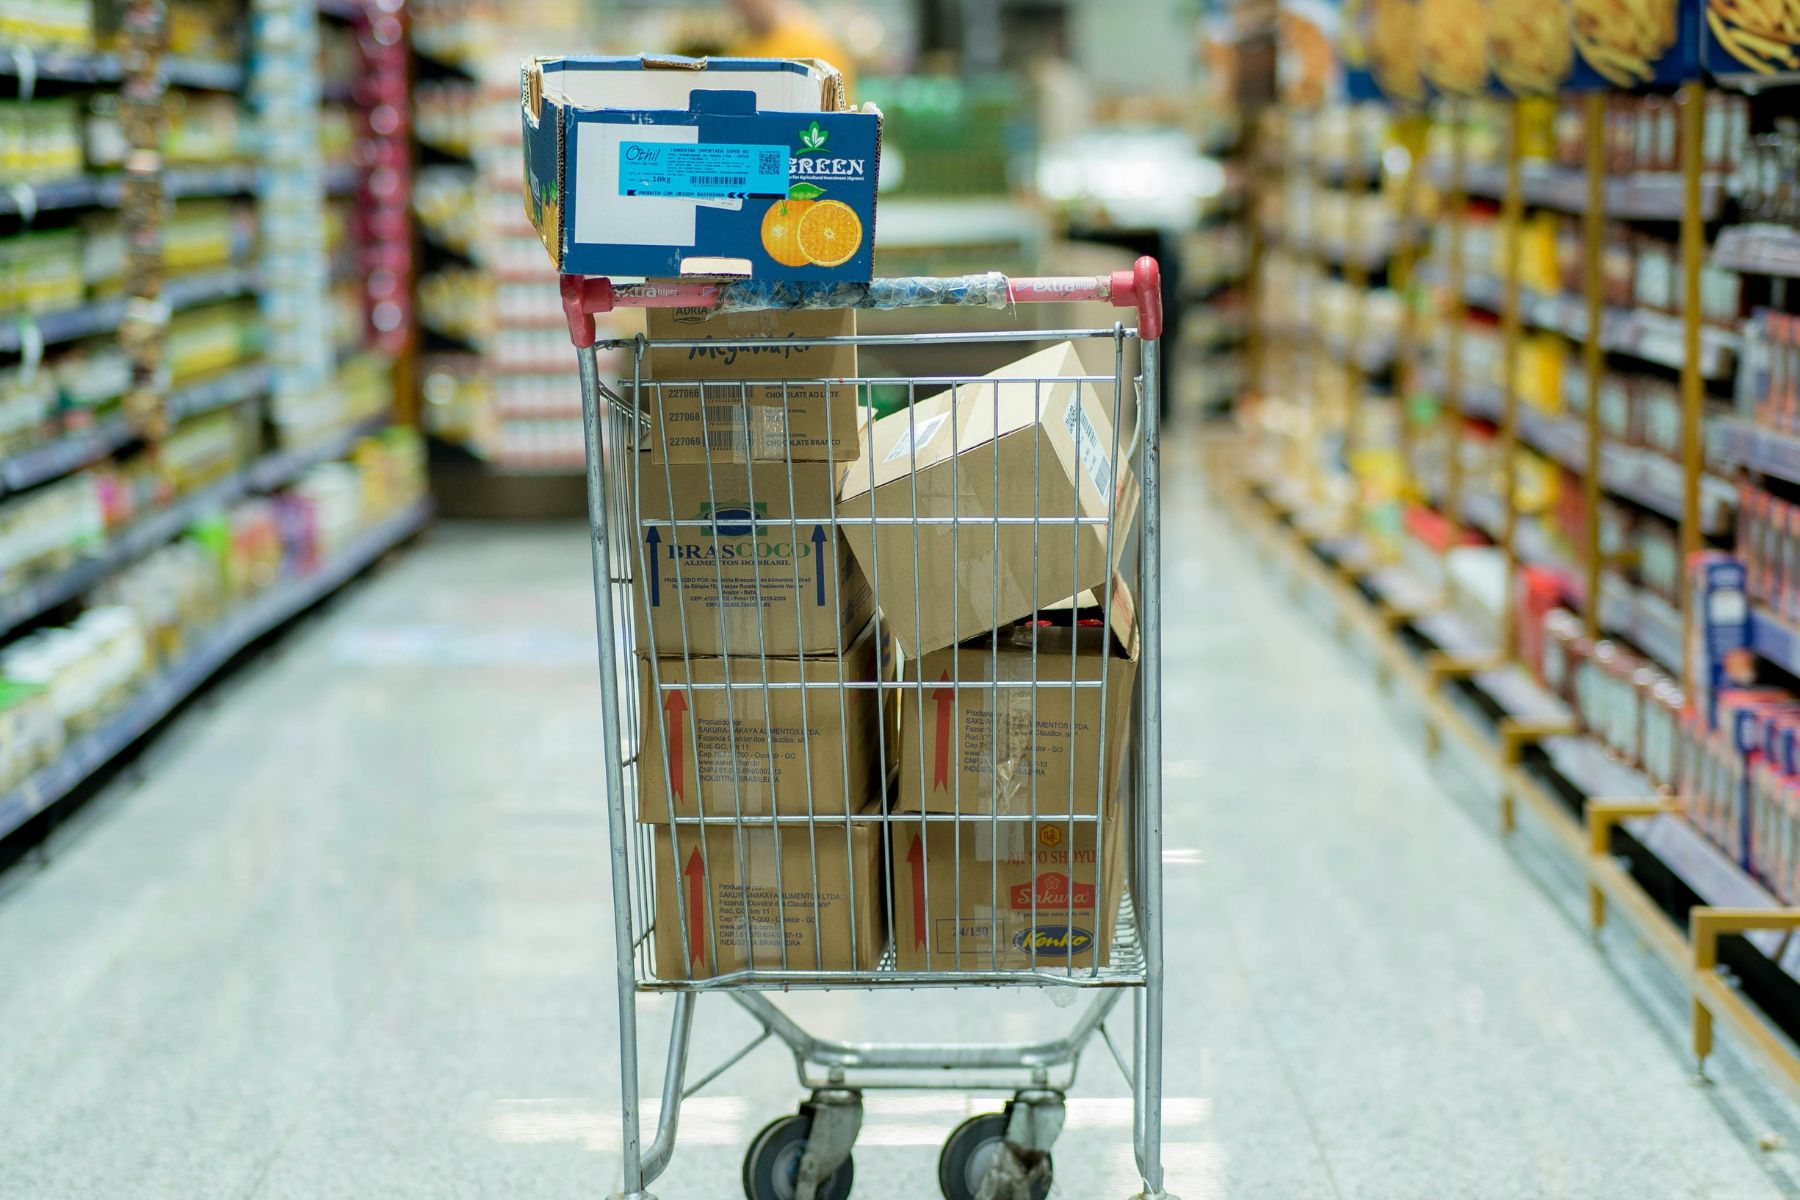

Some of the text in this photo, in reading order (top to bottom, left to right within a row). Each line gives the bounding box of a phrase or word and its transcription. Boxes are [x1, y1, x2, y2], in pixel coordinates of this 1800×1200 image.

[625, 145, 661, 161] Othil
[652, 176, 672, 184] 10kg
[676, 306, 709, 316] ADRIA
[669, 389, 700, 398] 227066
[809, 391, 819, 399] AO
[669, 412, 700, 422] 227068
[669, 437, 701, 446] 227069
[667, 543, 811, 560] BRASCOCO
[698, 727, 757, 735] SAKURA-AKAYA
[1050, 848, 1096, 865] SHOYU
[1022, 931, 1089, 949] Kenko
